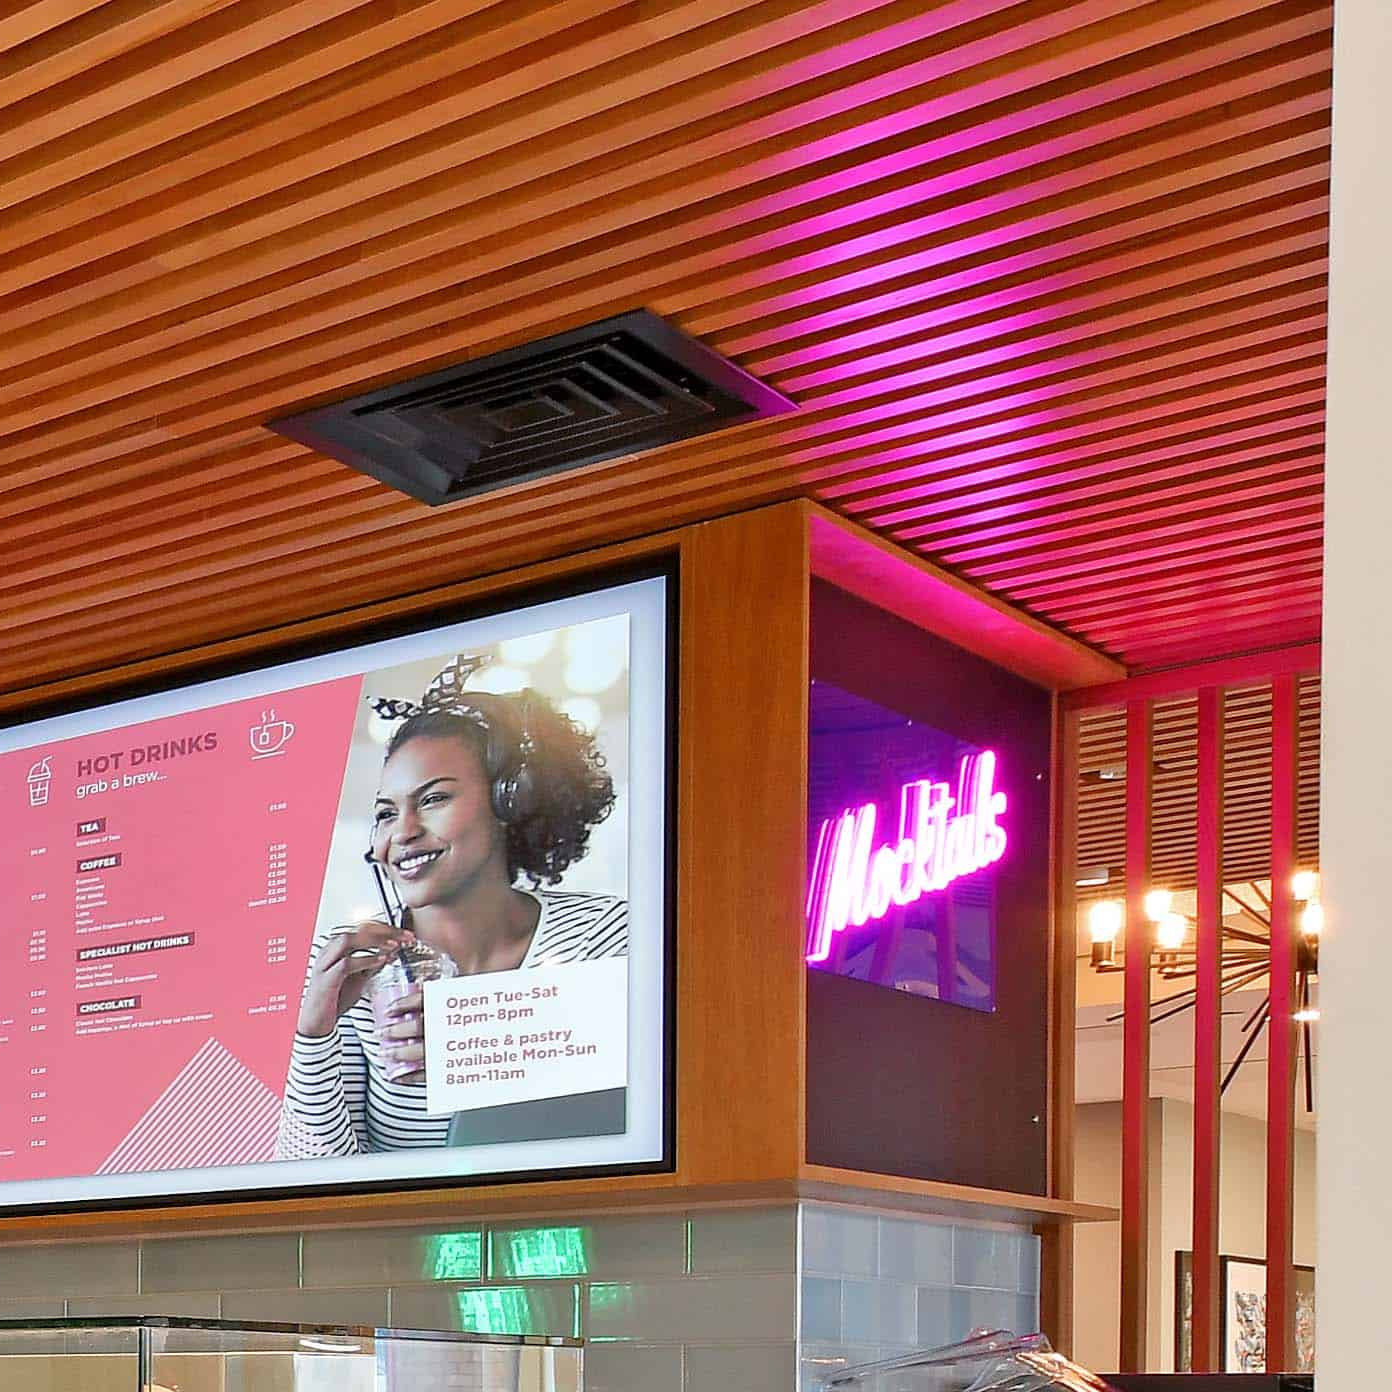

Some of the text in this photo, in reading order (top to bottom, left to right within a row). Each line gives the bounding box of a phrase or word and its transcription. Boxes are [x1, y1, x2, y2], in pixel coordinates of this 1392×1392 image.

[77, 732, 218, 777] HOT DRINKS
[76, 771, 167, 799] grab a brew...
[79, 821, 99, 834] TEA
[79, 856, 116, 871] COFFEE
[79, 935, 190, 960] SPECIALIST HOT DRINKS
[79, 998, 135, 1013] CHOCOLATE
[446, 986, 559, 1010] Open Tue-Sat
[446, 1007, 534, 1026] 12pm-8pm
[446, 1029, 573, 1052] Coffee & pastry
[446, 1043, 597, 1069] available Mon-Sun
[446, 1067, 526, 1085] 8am-11am
